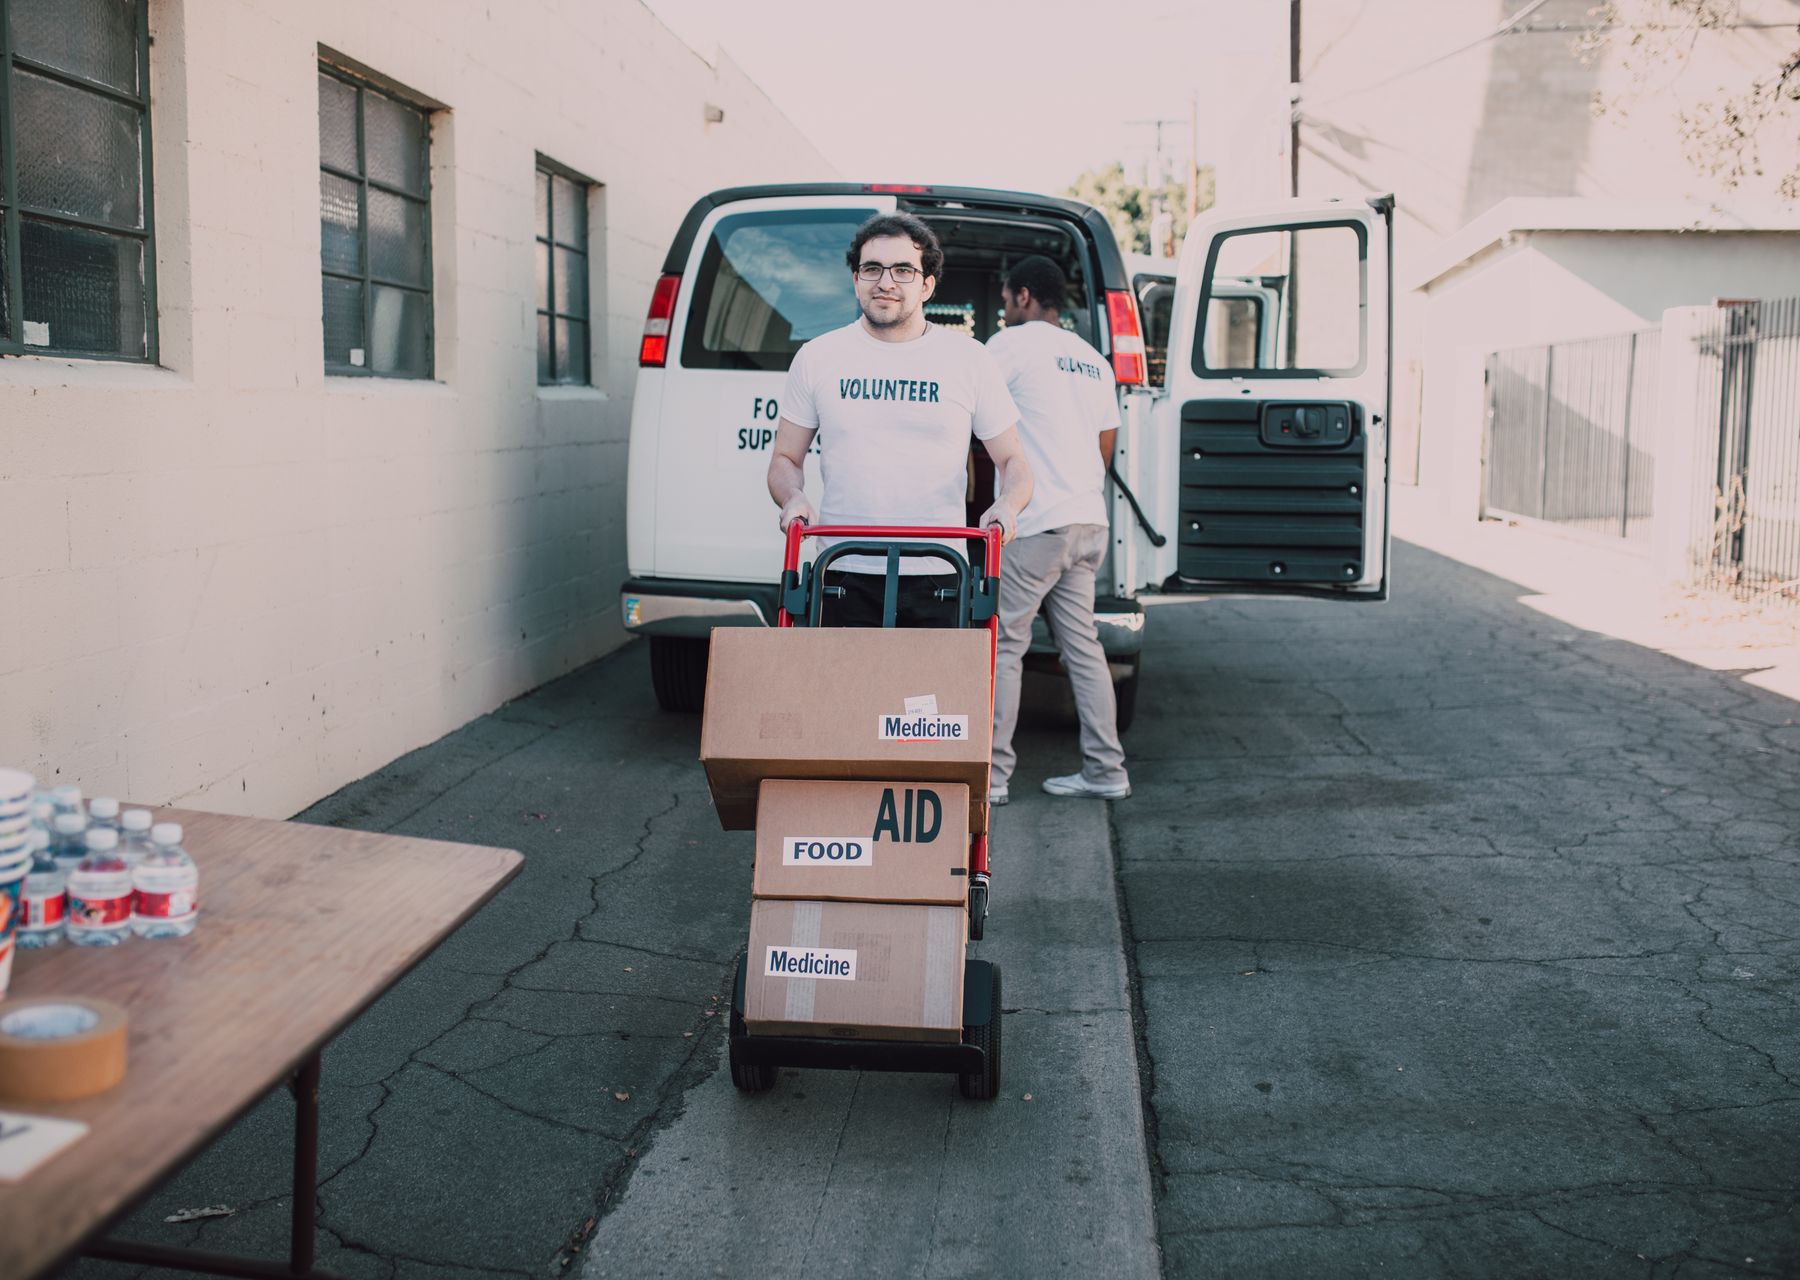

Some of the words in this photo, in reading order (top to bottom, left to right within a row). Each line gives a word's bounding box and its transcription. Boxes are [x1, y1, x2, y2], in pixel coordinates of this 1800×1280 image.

[840, 379, 939, 402] VOLUNTEER
[753, 398, 778, 420] FO
[885, 717, 961, 737] Medicine
[872, 788, 942, 843] AID
[794, 842, 862, 860] FOOD
[770, 950, 850, 976] Medicine
